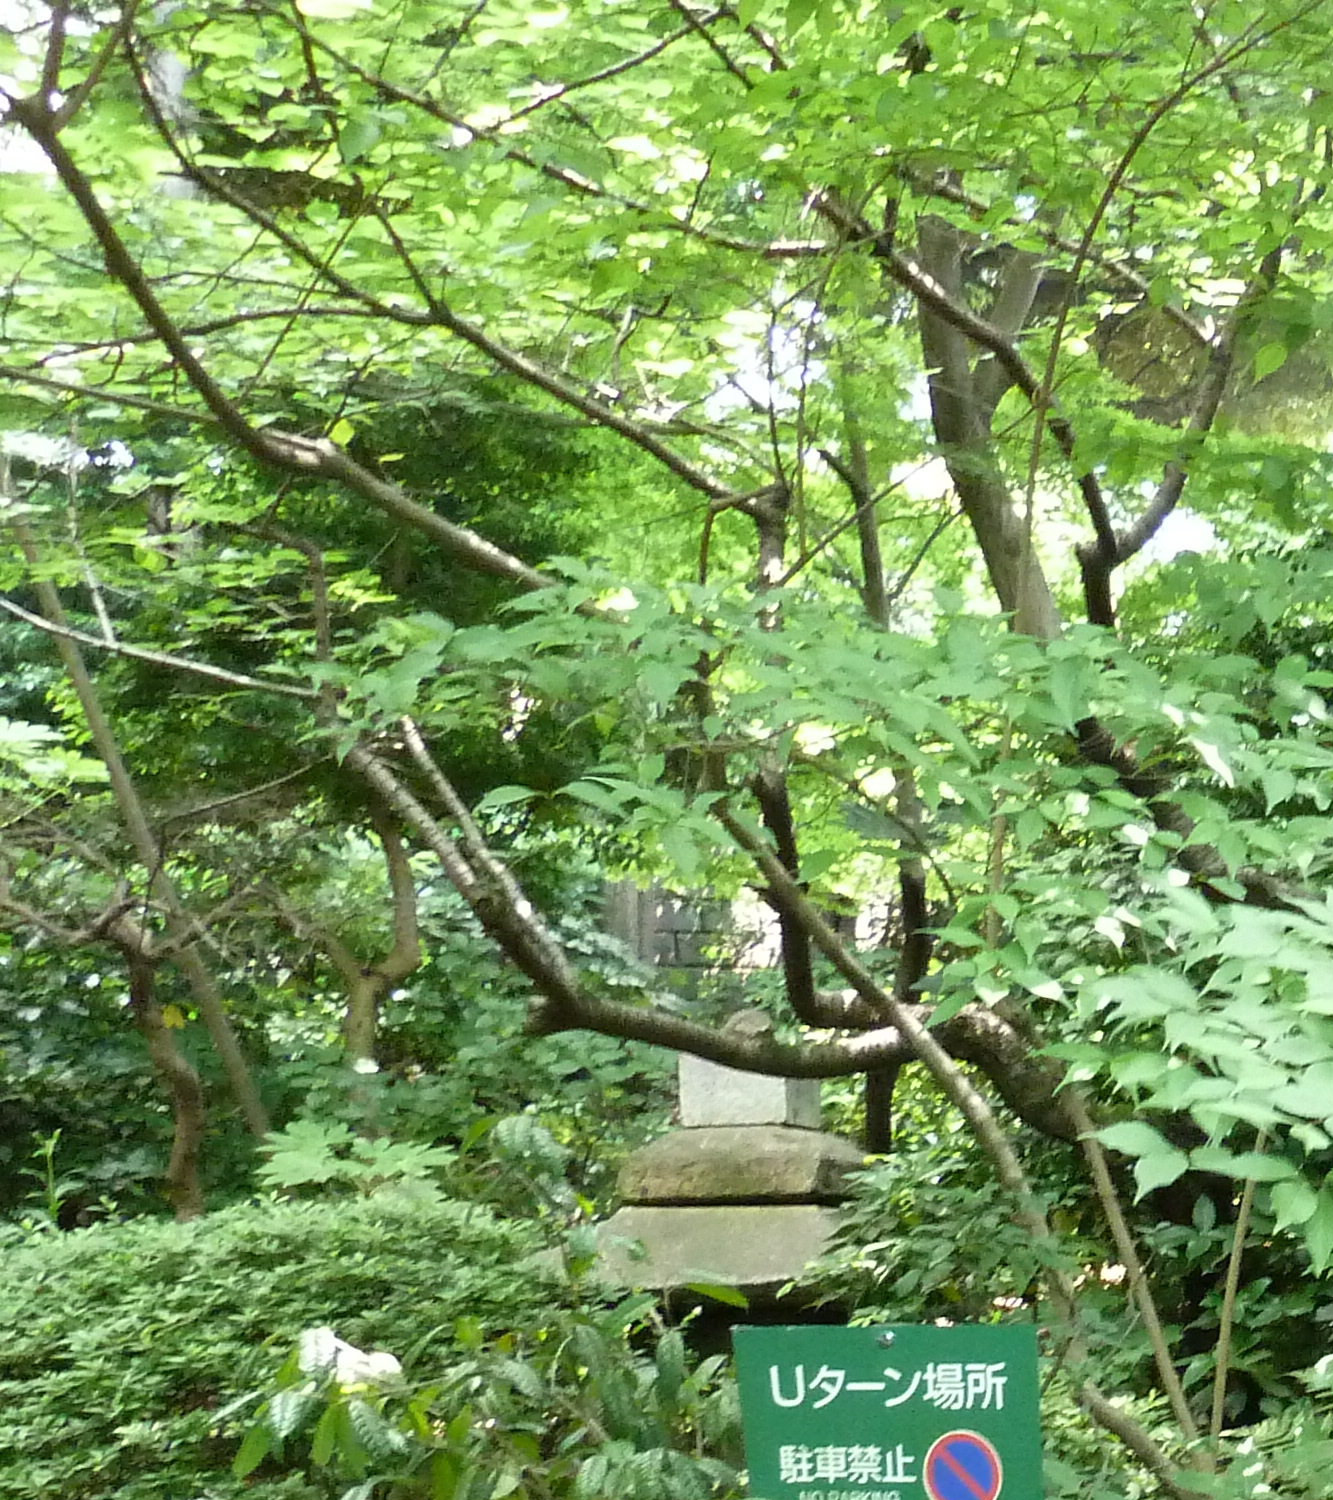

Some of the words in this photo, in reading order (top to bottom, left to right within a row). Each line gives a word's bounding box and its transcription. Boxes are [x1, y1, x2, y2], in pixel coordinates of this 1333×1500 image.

[769, 1362, 1007, 1410] Uターン場所
[779, 1444, 917, 1484] 駐車禁止
